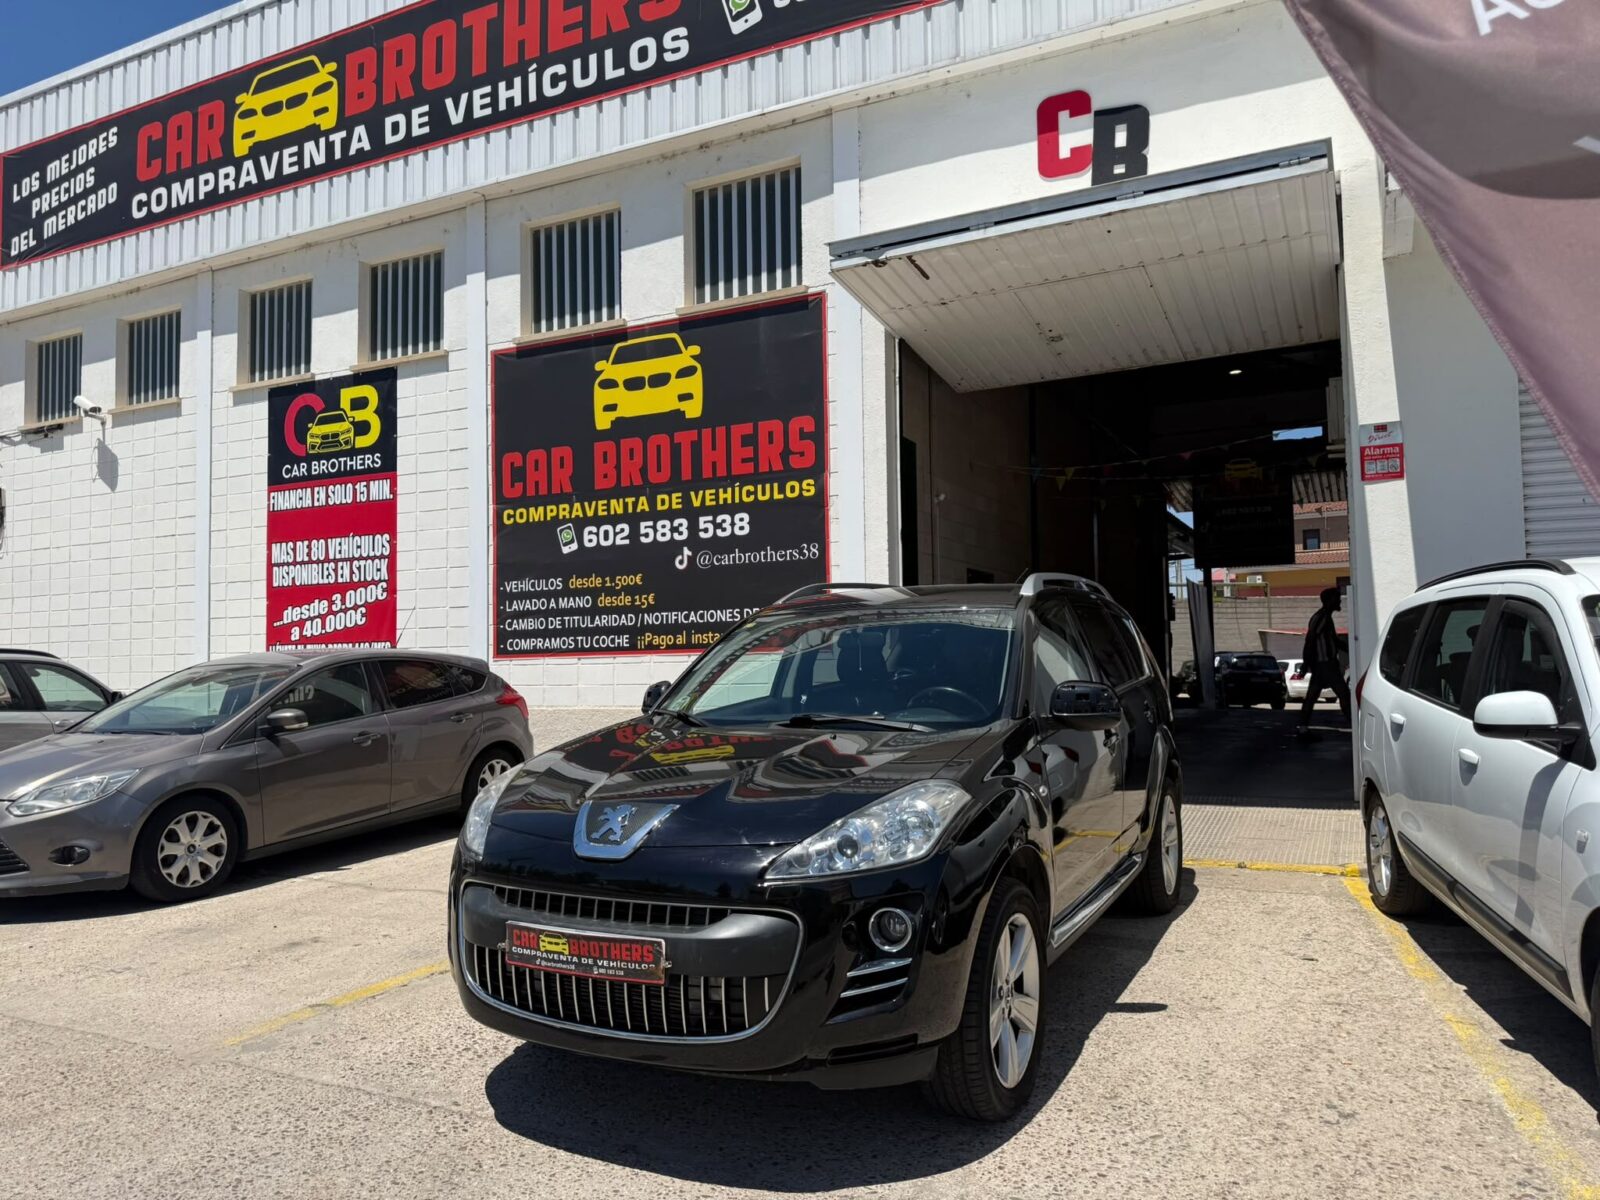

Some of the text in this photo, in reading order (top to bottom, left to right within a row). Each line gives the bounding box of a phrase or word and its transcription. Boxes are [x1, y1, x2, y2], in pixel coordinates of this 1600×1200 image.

[131, 26, 690, 219] COMPRAVENTA DE VEHÍCULOS
[1037, 90, 1149, 186] CB
[136, 100, 225, 182] CAR
[13, 126, 118, 203] LOS MEJORES
[32, 166, 95, 219] PRECIOS
[10, 182, 118, 257] DEL MERCADO
[282, 453, 381, 479] CAR BROTHERS
[502, 415, 816, 499] CAR BROTHERS
[1364, 446, 1400, 456] Alarma
[269, 479, 393, 512] FINANCIA EN SOLO 15 MIN.
[503, 479, 816, 525] COMPRAVENTA DE VEHÍCULOS
[583, 512, 750, 548] 602 583 538
[271, 532, 391, 564] MAS DE 80 VEHÍCULOS
[696, 543, 819, 569] @carbrothers38
[272, 558, 388, 588] DISPONIBLES EN STOCK
[505, 573, 643, 593] VEHÍCULOS desde 1.500€
[331, 582, 388, 612] 3.000€
[506, 592, 655, 612] LAVADO A MANO desde 15€
[291, 607, 367, 641] a 40.000€
[505, 617, 546, 631] CAMBIO
[548, 617, 562, 629] DE
[563, 613, 636, 629] TITULARIDAD
[644, 609, 741, 625] NOTIFICACIONES
[506, 637, 575, 651] COMPRAMOS
[576, 636, 591, 649] TU
[593, 635, 630, 649] COCHE
[676, 630, 686, 645] al
[692, 630, 723, 645] insta
[512, 946, 579, 963] COMPRAVENTA
[581, 957, 594, 965] DE
[513, 929, 654, 963] CAR BROTHERS
